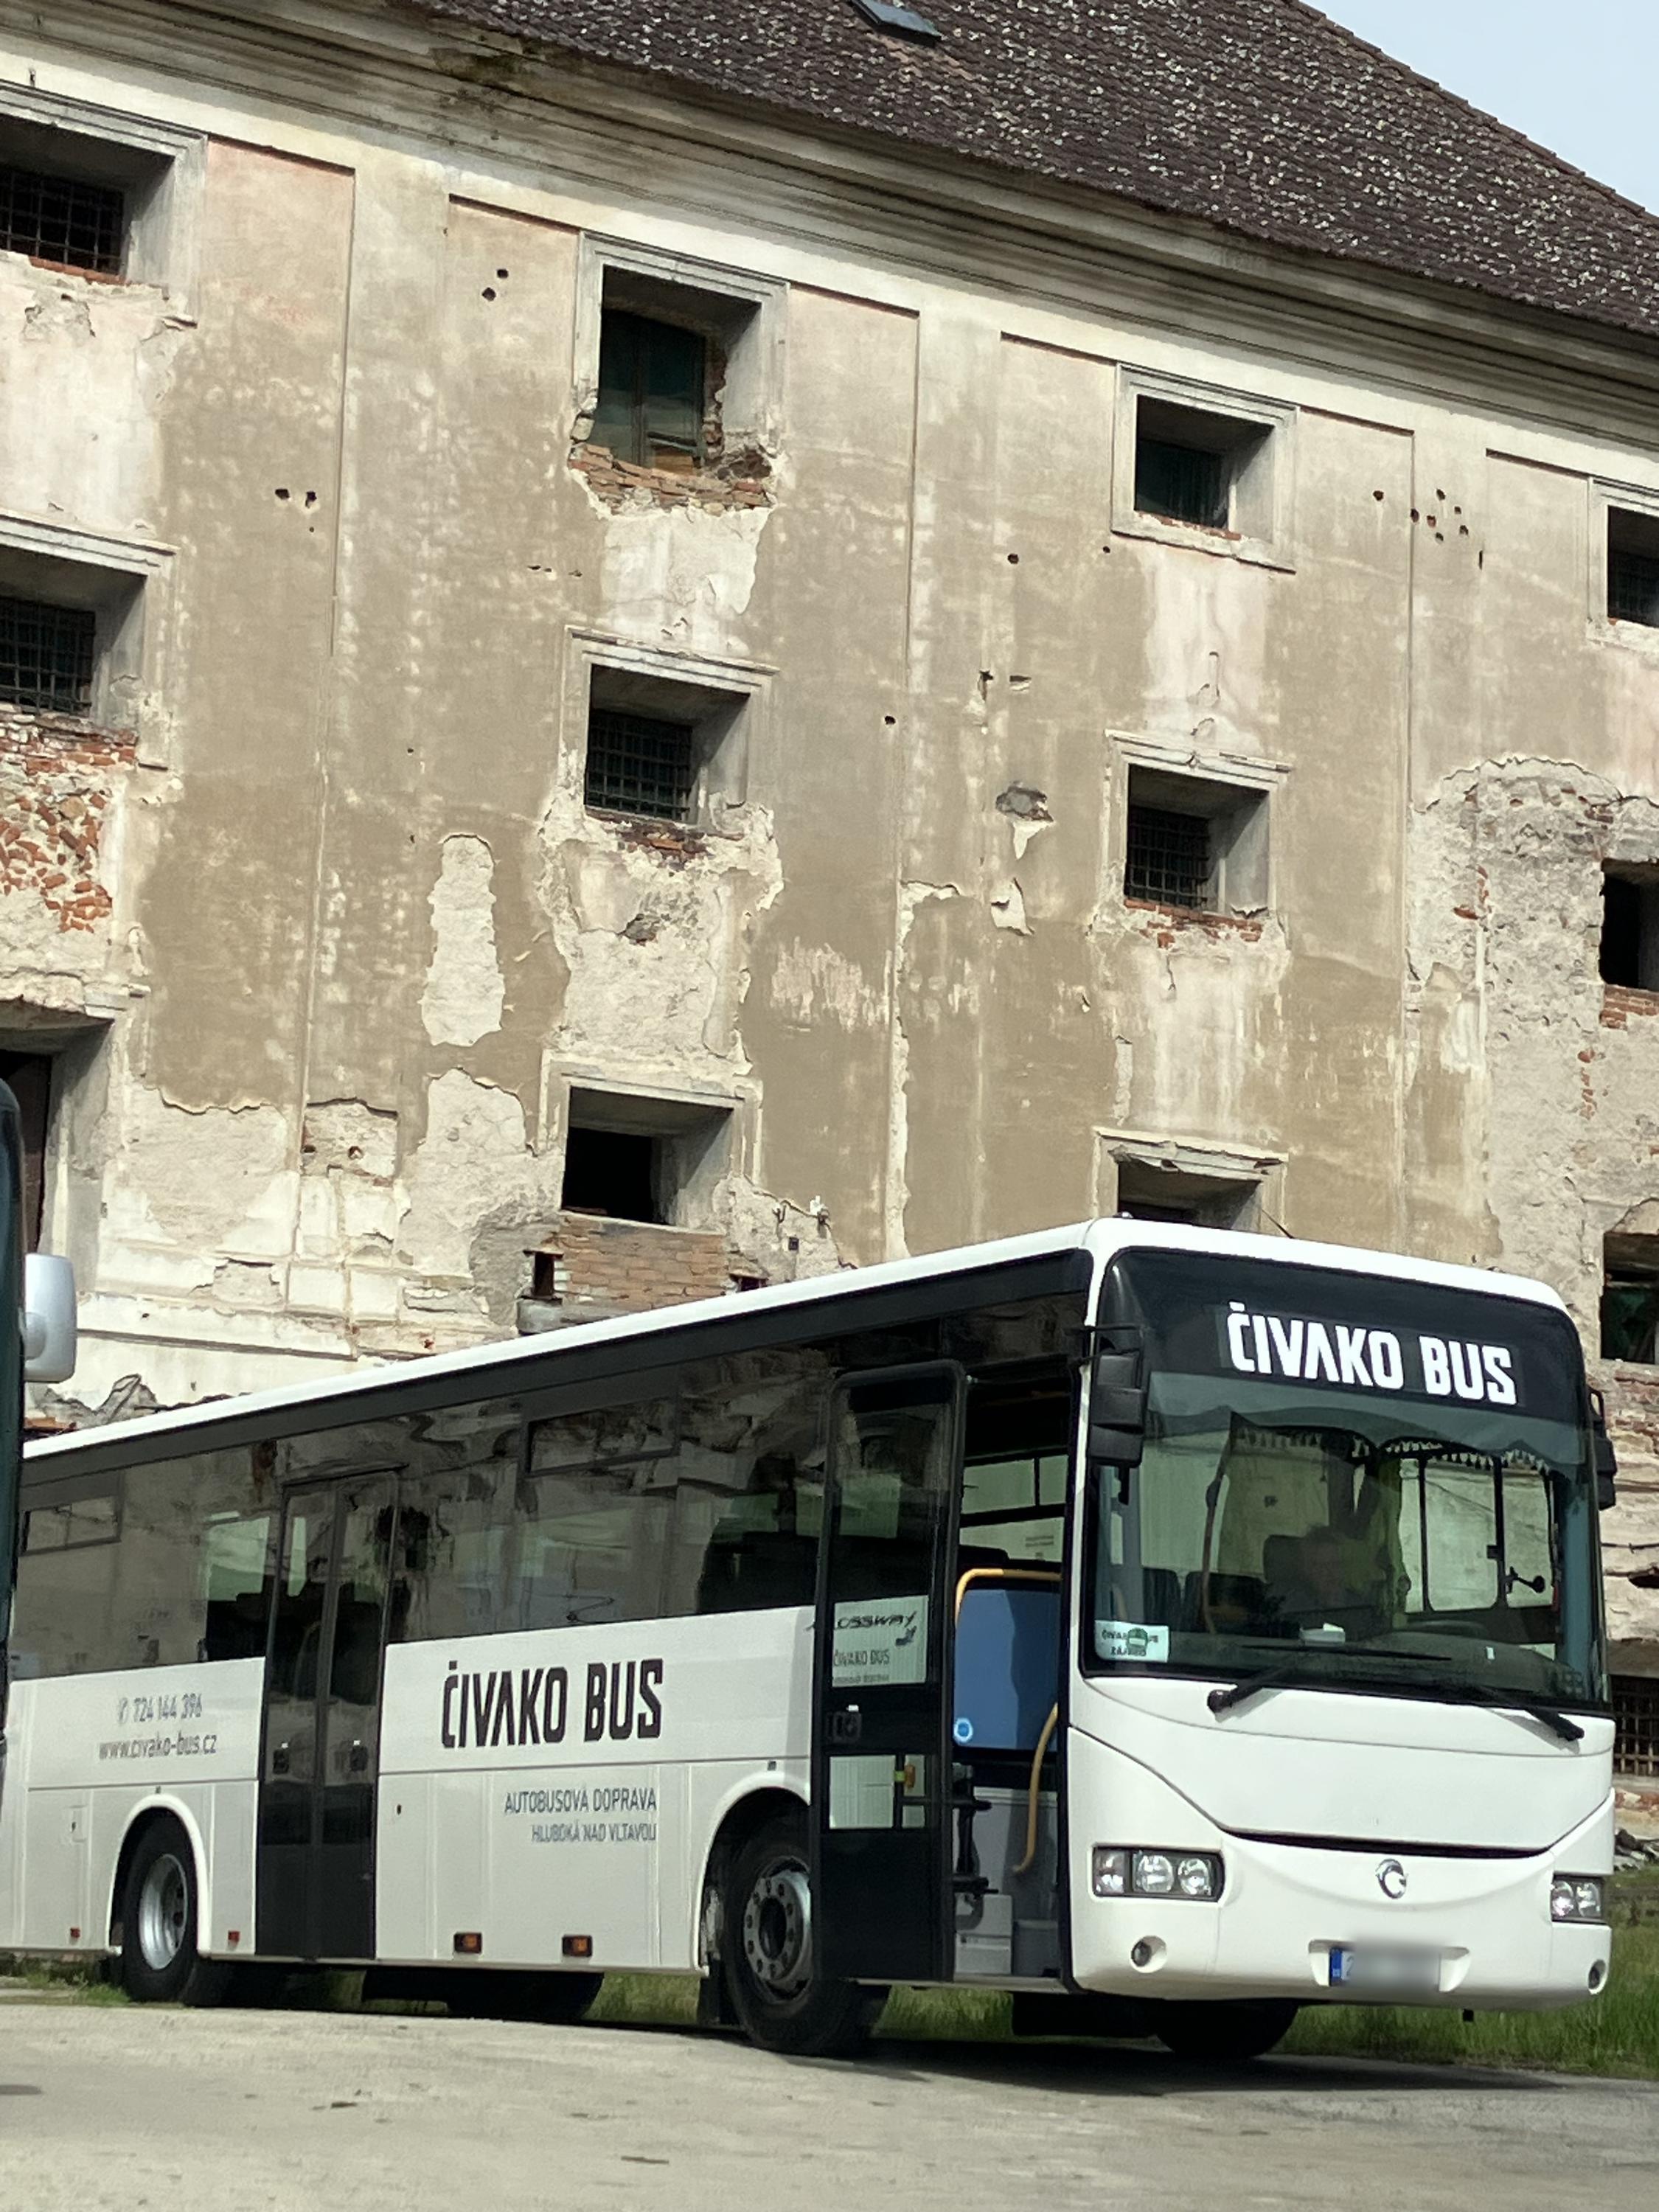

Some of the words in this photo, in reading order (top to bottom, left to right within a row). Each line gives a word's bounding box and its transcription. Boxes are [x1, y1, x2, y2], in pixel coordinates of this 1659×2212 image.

[1419, 1335, 1517, 1406] BUS
[133, 1696, 154, 1722] 724
[158, 1694, 178, 1720] 144
[181, 1691, 203, 1719] 396
[583, 1658, 664, 1743] BUS
[99, 1730, 217, 1760] www.civako-bus.cz
[504, 1784, 589, 1814] AUTOBUSOVÁ
[593, 1787, 657, 1812] DOPRAVA
[531, 1820, 580, 1844] HLUBOKÁ
[582, 1823, 607, 1843] NAD
[609, 1823, 657, 1843] VLTAVOU
